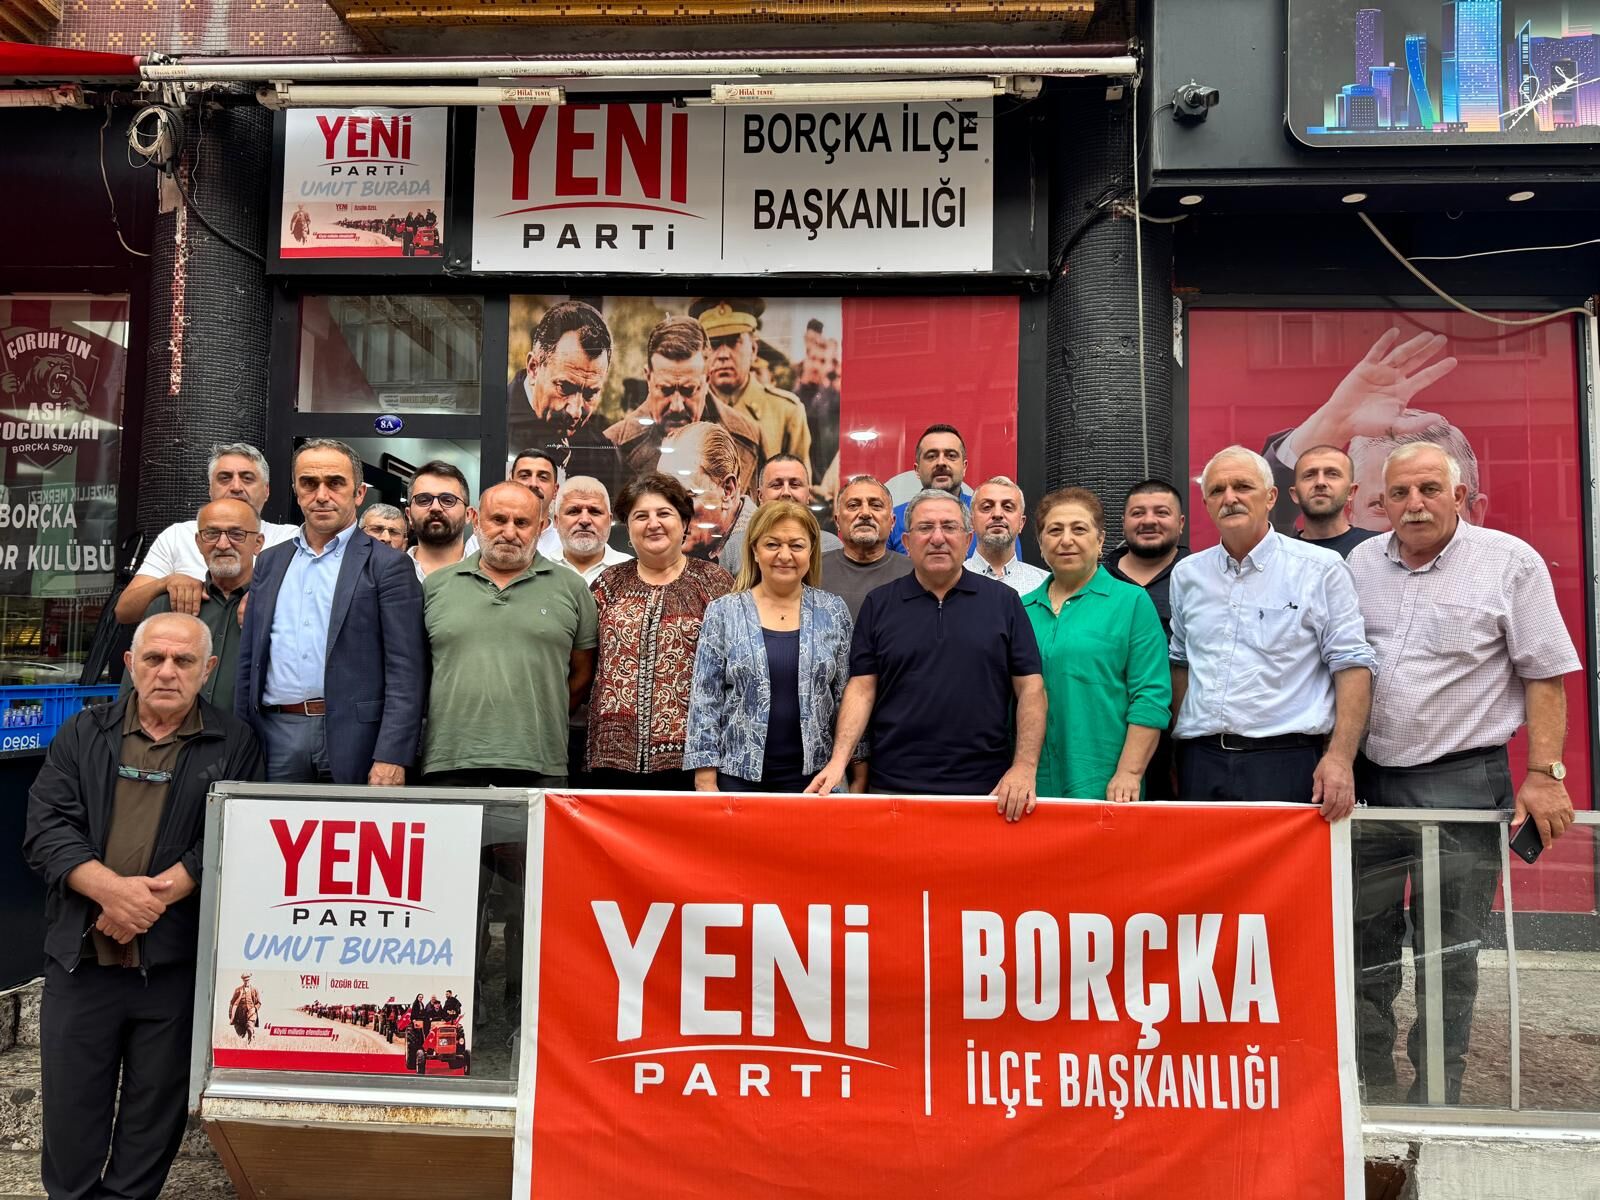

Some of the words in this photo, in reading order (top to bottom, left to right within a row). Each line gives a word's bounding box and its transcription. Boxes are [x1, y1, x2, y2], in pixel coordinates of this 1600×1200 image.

[743, 111, 892, 164] BORÇKA
[901, 103, 979, 163] İLÇE
[300, 180, 357, 197] UMUT
[360, 179, 431, 197] BURADA
[753, 176, 966, 241] BAŞKANLIĞI
[0, 419, 99, 440] OCUKLARI
[380, 420, 394, 429] 8A
[52, 443, 73, 454] SPOR
[0, 503, 77, 533] BORÇKA
[27, 538, 115, 572] KULÜBÜ
[3, 732, 40, 751] pepsi
[243, 932, 334, 964] UMUT
[339, 936, 453, 967] BURADA
[961, 909, 1281, 1050] BORÇKA
[966, 1039, 1043, 1119] İLÇE
[1058, 1044, 1279, 1120] BAŞKANLIĞI
